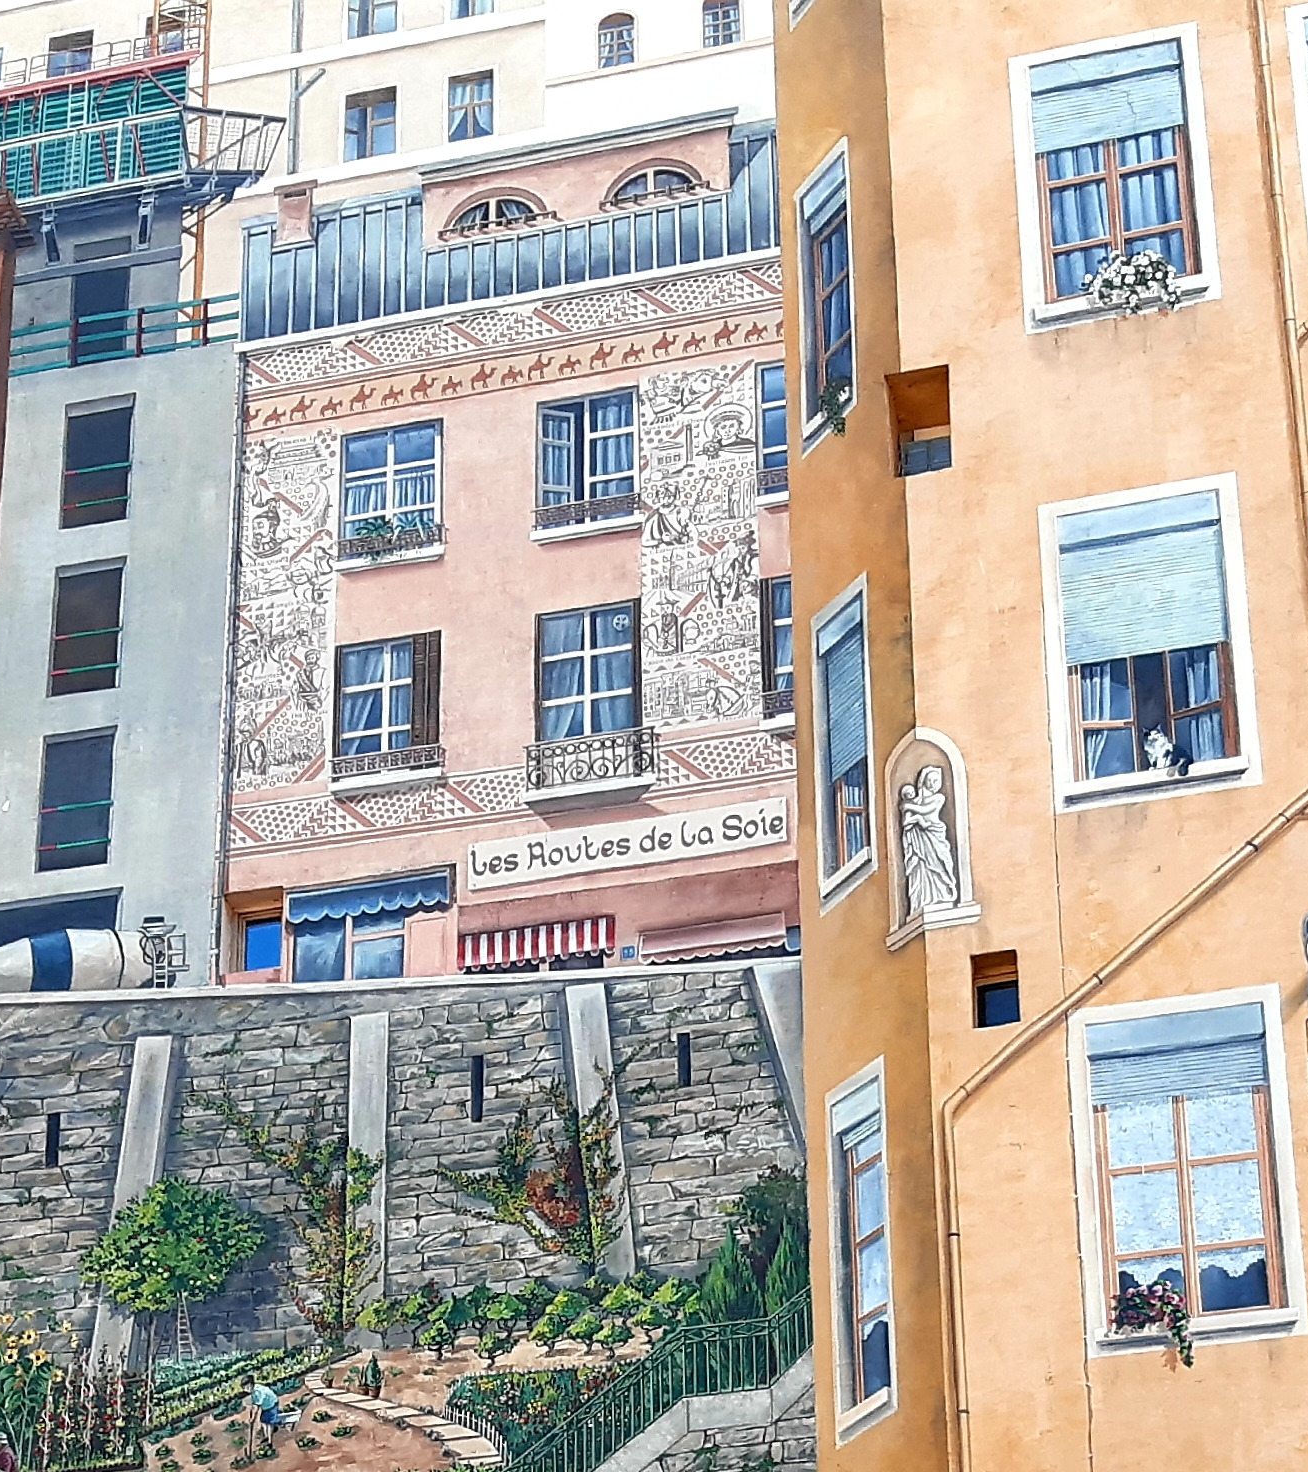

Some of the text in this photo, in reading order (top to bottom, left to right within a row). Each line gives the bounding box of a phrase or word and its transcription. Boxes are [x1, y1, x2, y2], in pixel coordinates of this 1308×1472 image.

[470, 808, 784, 876] Les Routes de La Soie
